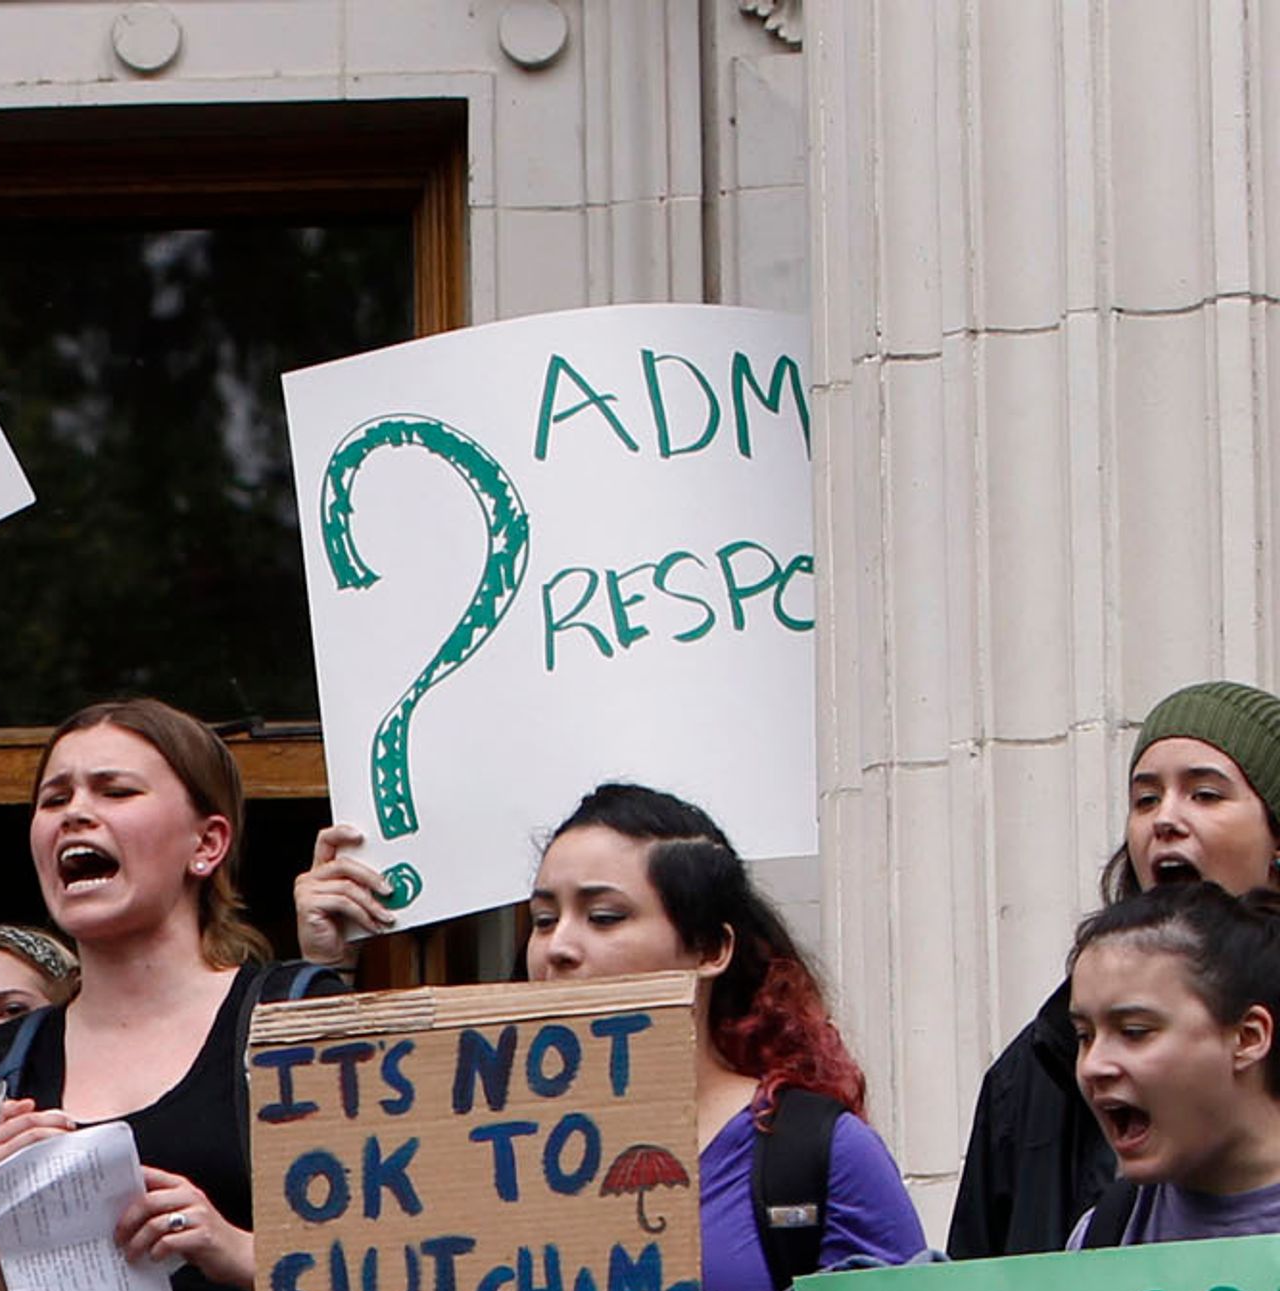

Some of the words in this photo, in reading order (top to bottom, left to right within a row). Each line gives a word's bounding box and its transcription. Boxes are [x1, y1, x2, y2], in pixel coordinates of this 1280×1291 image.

[533, 349, 812, 461] ADM
[251, 1036, 417, 1124] IT'S
[451, 1013, 652, 1115] NOT
[283, 1135, 423, 1224] OK
[468, 1111, 603, 1203] TO
